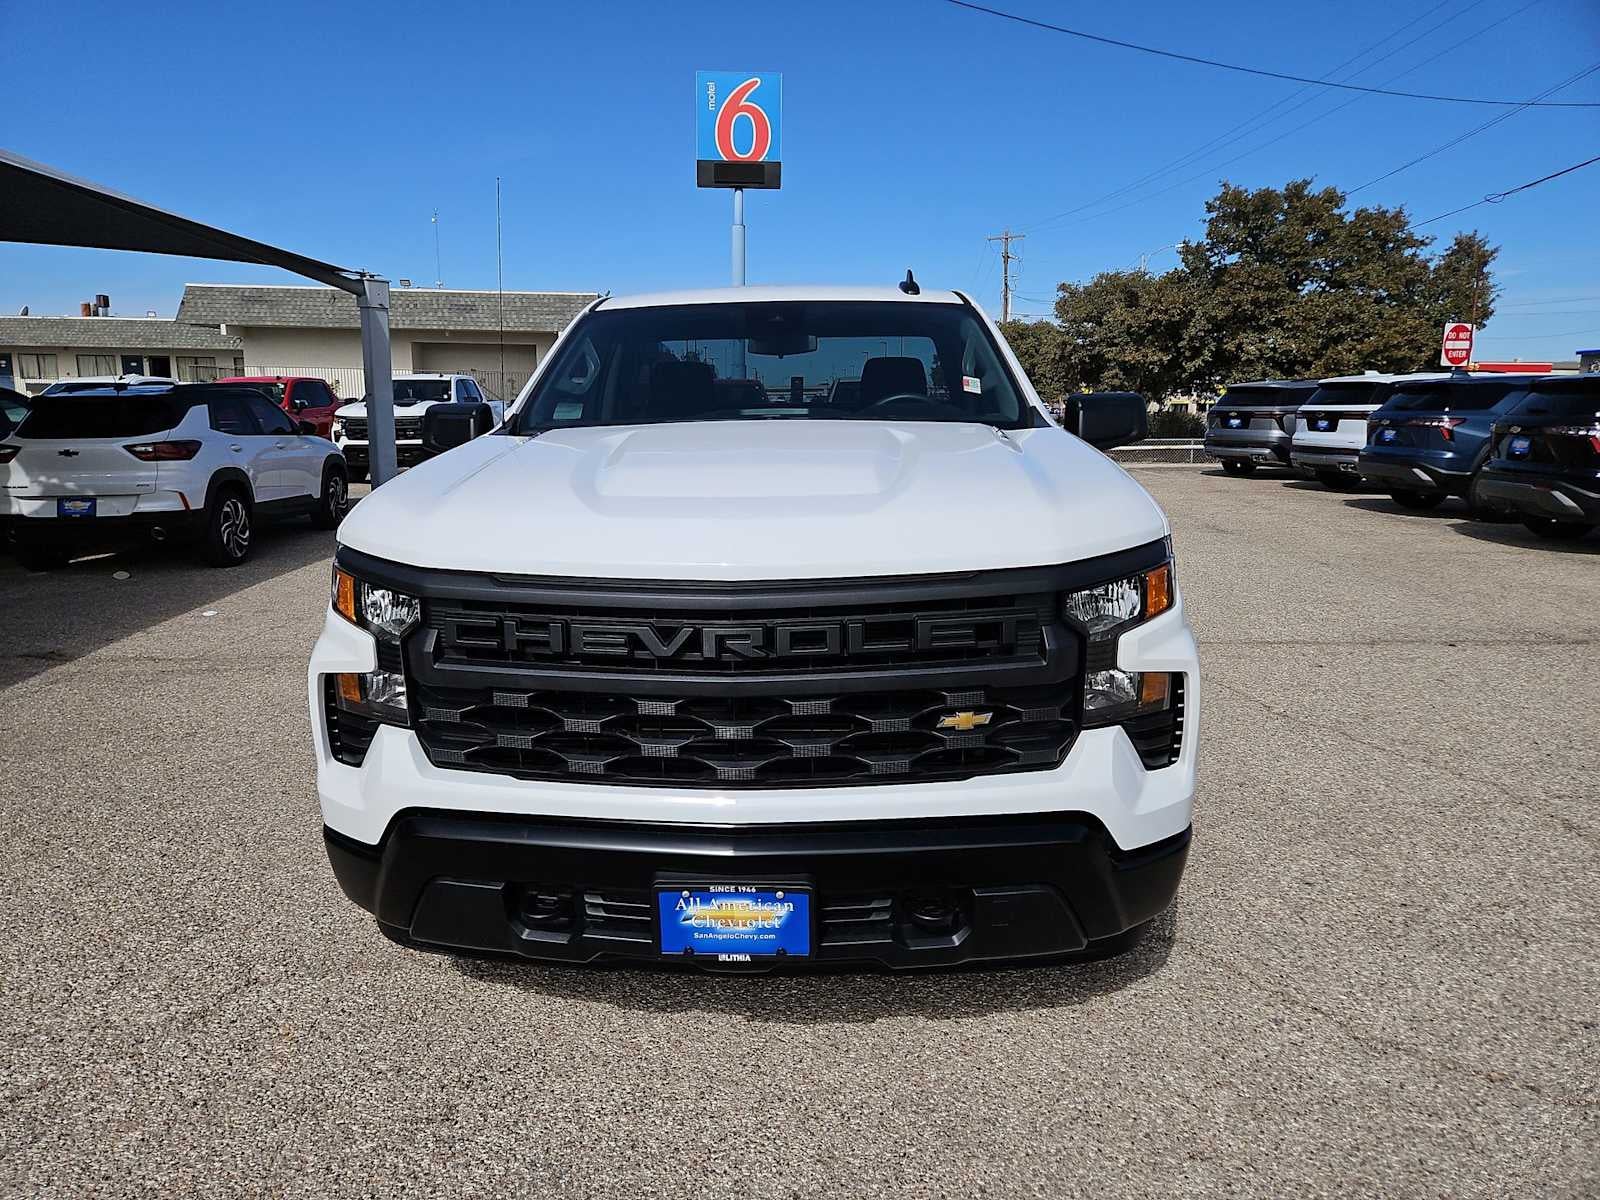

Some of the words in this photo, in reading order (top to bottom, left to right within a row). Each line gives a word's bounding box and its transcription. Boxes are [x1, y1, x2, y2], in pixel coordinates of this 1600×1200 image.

[707, 82, 716, 110] motel
[715, 77, 771, 161] 6
[1448, 350, 1467, 358] ENTER
[445, 612, 1037, 660] CHEVROLET
[675, 897, 701, 911] All
[707, 898, 795, 912] American
[690, 914, 782, 929] Chevrolet
[693, 932, 776, 941] SanAngeloChevy.com
